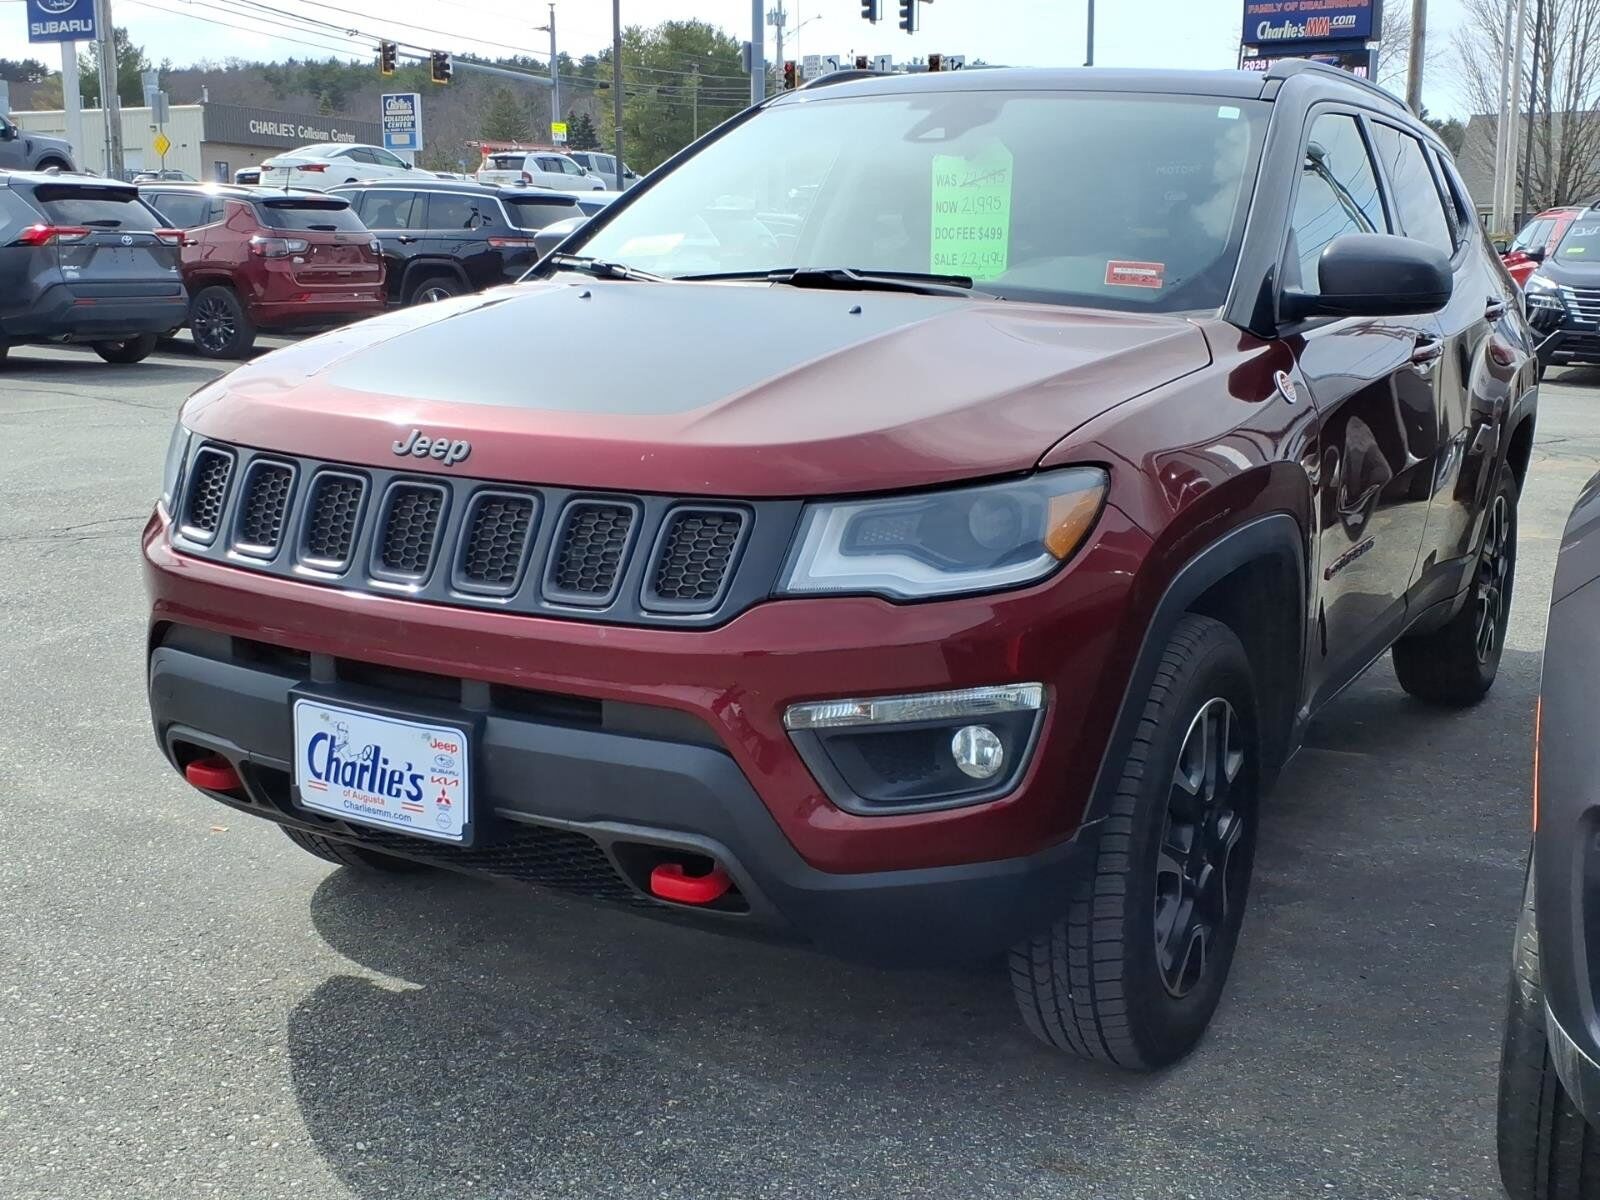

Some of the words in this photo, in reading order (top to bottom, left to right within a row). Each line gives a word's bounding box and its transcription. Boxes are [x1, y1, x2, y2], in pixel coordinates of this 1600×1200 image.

[1247, 4, 1281, 14] FAMILY
[1284, 2, 1297, 11] OF
[31, 19, 93, 35] SUBARU
[249, 120, 295, 137] CHARLIE'S
[297, 125, 329, 140] Collision
[331, 129, 355, 143] Center
[935, 174, 957, 187] WAS
[935, 201, 958, 214] NOW
[934, 227, 955, 240] DOC
[956, 227, 976, 240] FEE
[977, 226, 1003, 240] $499
[934, 253, 957, 266] SALE
[391, 428, 472, 467] Jeep
[430, 737, 458, 753] Jeep
[307, 731, 425, 802] Charlie's
[430, 766, 459, 777] SUBARU
[343, 789, 351, 797] of
[351, 791, 385, 806] Augusta
[343, 799, 412, 822] Charliesmm.com
